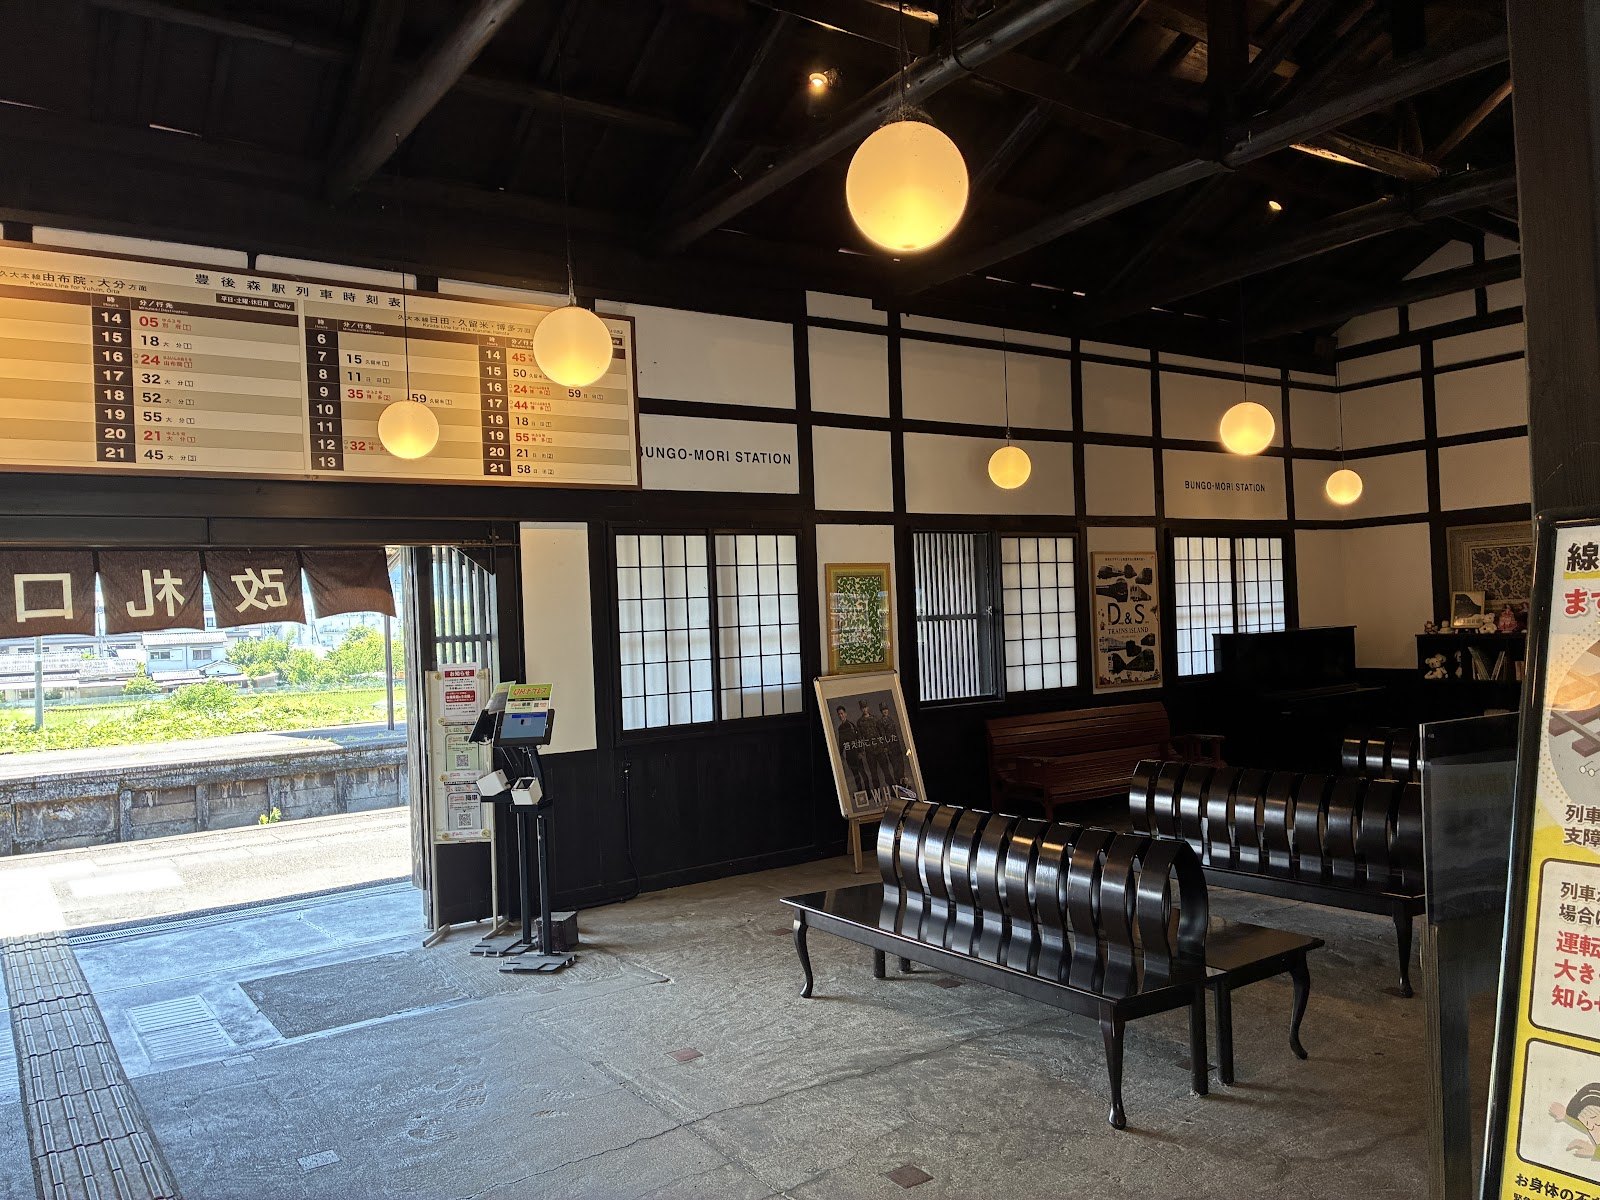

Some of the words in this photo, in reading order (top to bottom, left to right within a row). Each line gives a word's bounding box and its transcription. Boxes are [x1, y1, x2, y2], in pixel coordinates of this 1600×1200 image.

[274, 302, 291, 310] Daily
[101, 312, 121, 324] 14
[139, 316, 159, 327] 05
[102, 331, 122, 343] 15
[141, 335, 159, 346] 18
[317, 333, 326, 344] 6
[102, 350, 123, 362] 16
[140, 354, 160, 366] 24
[317, 351, 327, 362] 7
[346, 353, 362, 364] 15
[486, 349, 501, 360] 14
[512, 353, 526, 362] 45
[103, 370, 124, 381] 17
[141, 373, 161, 385] 32
[319, 369, 328, 379] 8
[347, 371, 361, 382] 11
[486, 366, 501, 376] 15
[513, 369, 527, 378] 50
[103, 389, 125, 400] 18
[142, 392, 162, 404] 52
[320, 386, 329, 397] 9
[347, 389, 364, 399] 35
[411, 393, 427, 403] 59
[487, 382, 502, 392] 16
[513, 384, 528, 394] 24
[568, 389, 581, 398] 59
[316, 403, 334, 414] 10
[487, 398, 503, 408] 17
[514, 400, 528, 410] 44
[104, 408, 125, 420] 19
[143, 411, 162, 422] 55
[488, 414, 504, 425] 18
[516, 416, 529, 426] 18
[316, 421, 333, 433] 11
[104, 428, 126, 439] 20
[144, 430, 161, 441] 21
[488, 430, 504, 440] 19
[515, 432, 529, 442] 55
[318, 439, 335, 450] 12
[349, 440, 366, 451] 32
[105, 447, 125, 458] 21
[144, 450, 163, 460] 45
[489, 446, 505, 457] 20
[516, 448, 529, 458] 21
[735, 451, 791, 465] STATION
[318, 456, 336, 468] 13
[489, 463, 504, 473] 21
[517, 464, 531, 474] 58
[1184, 480, 1234, 491] BUNGO-MORI
[1235, 482, 1265, 492] STATION
[1566, 541, 1600, 572] 線
[842, 734, 898, 751] 答えがここでした
[1565, 804, 1600, 824] 列車
[1563, 827, 1600, 847] 支障
[1560, 881, 1600, 902] 列車
[1555, 930, 1600, 959] 運転
[1553, 958, 1600, 985] 大き
[1514, 1173, 1600, 1200] お身体の不
